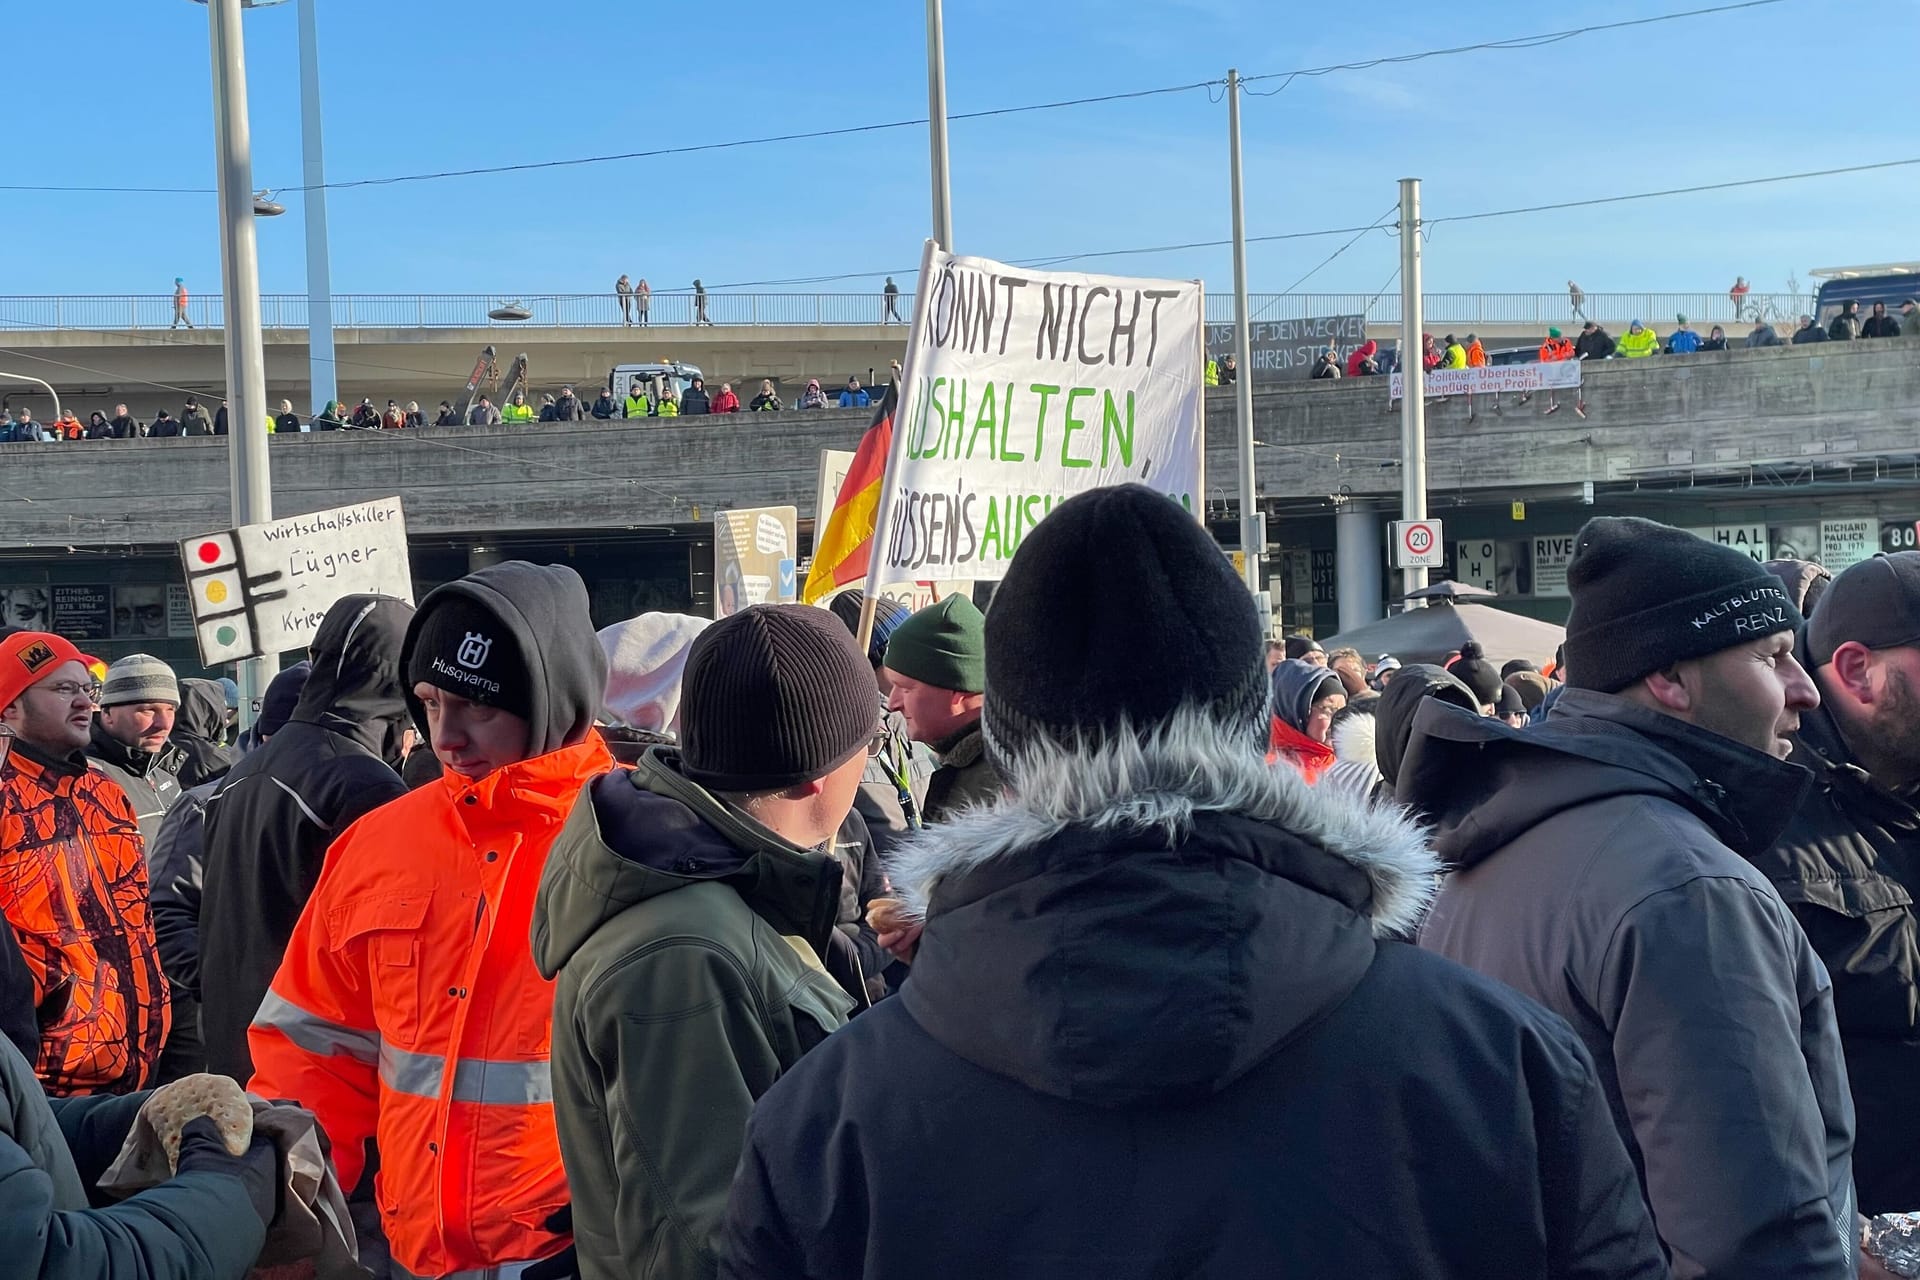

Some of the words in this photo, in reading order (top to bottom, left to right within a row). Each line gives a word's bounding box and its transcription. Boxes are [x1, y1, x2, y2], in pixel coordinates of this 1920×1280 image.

[1036, 281, 1180, 367] NICHT
[1268, 321, 1298, 341] DEN
[1302, 316, 1366, 339] WECKER
[906, 376, 1151, 480] USHALTEN,
[264, 506, 396, 542] Wirtschaftskiller
[1824, 522, 1867, 532] RICHARD
[1824, 532, 1865, 541] PAULICK
[1412, 532, 1428, 546] 20
[1537, 538, 1572, 556] RIVE
[290, 546, 378, 578] Lügner
[1410, 555, 1431, 564] ZONE
[1735, 607, 1787, 635] RENZ
[431, 656, 501, 693] Husqvarna
